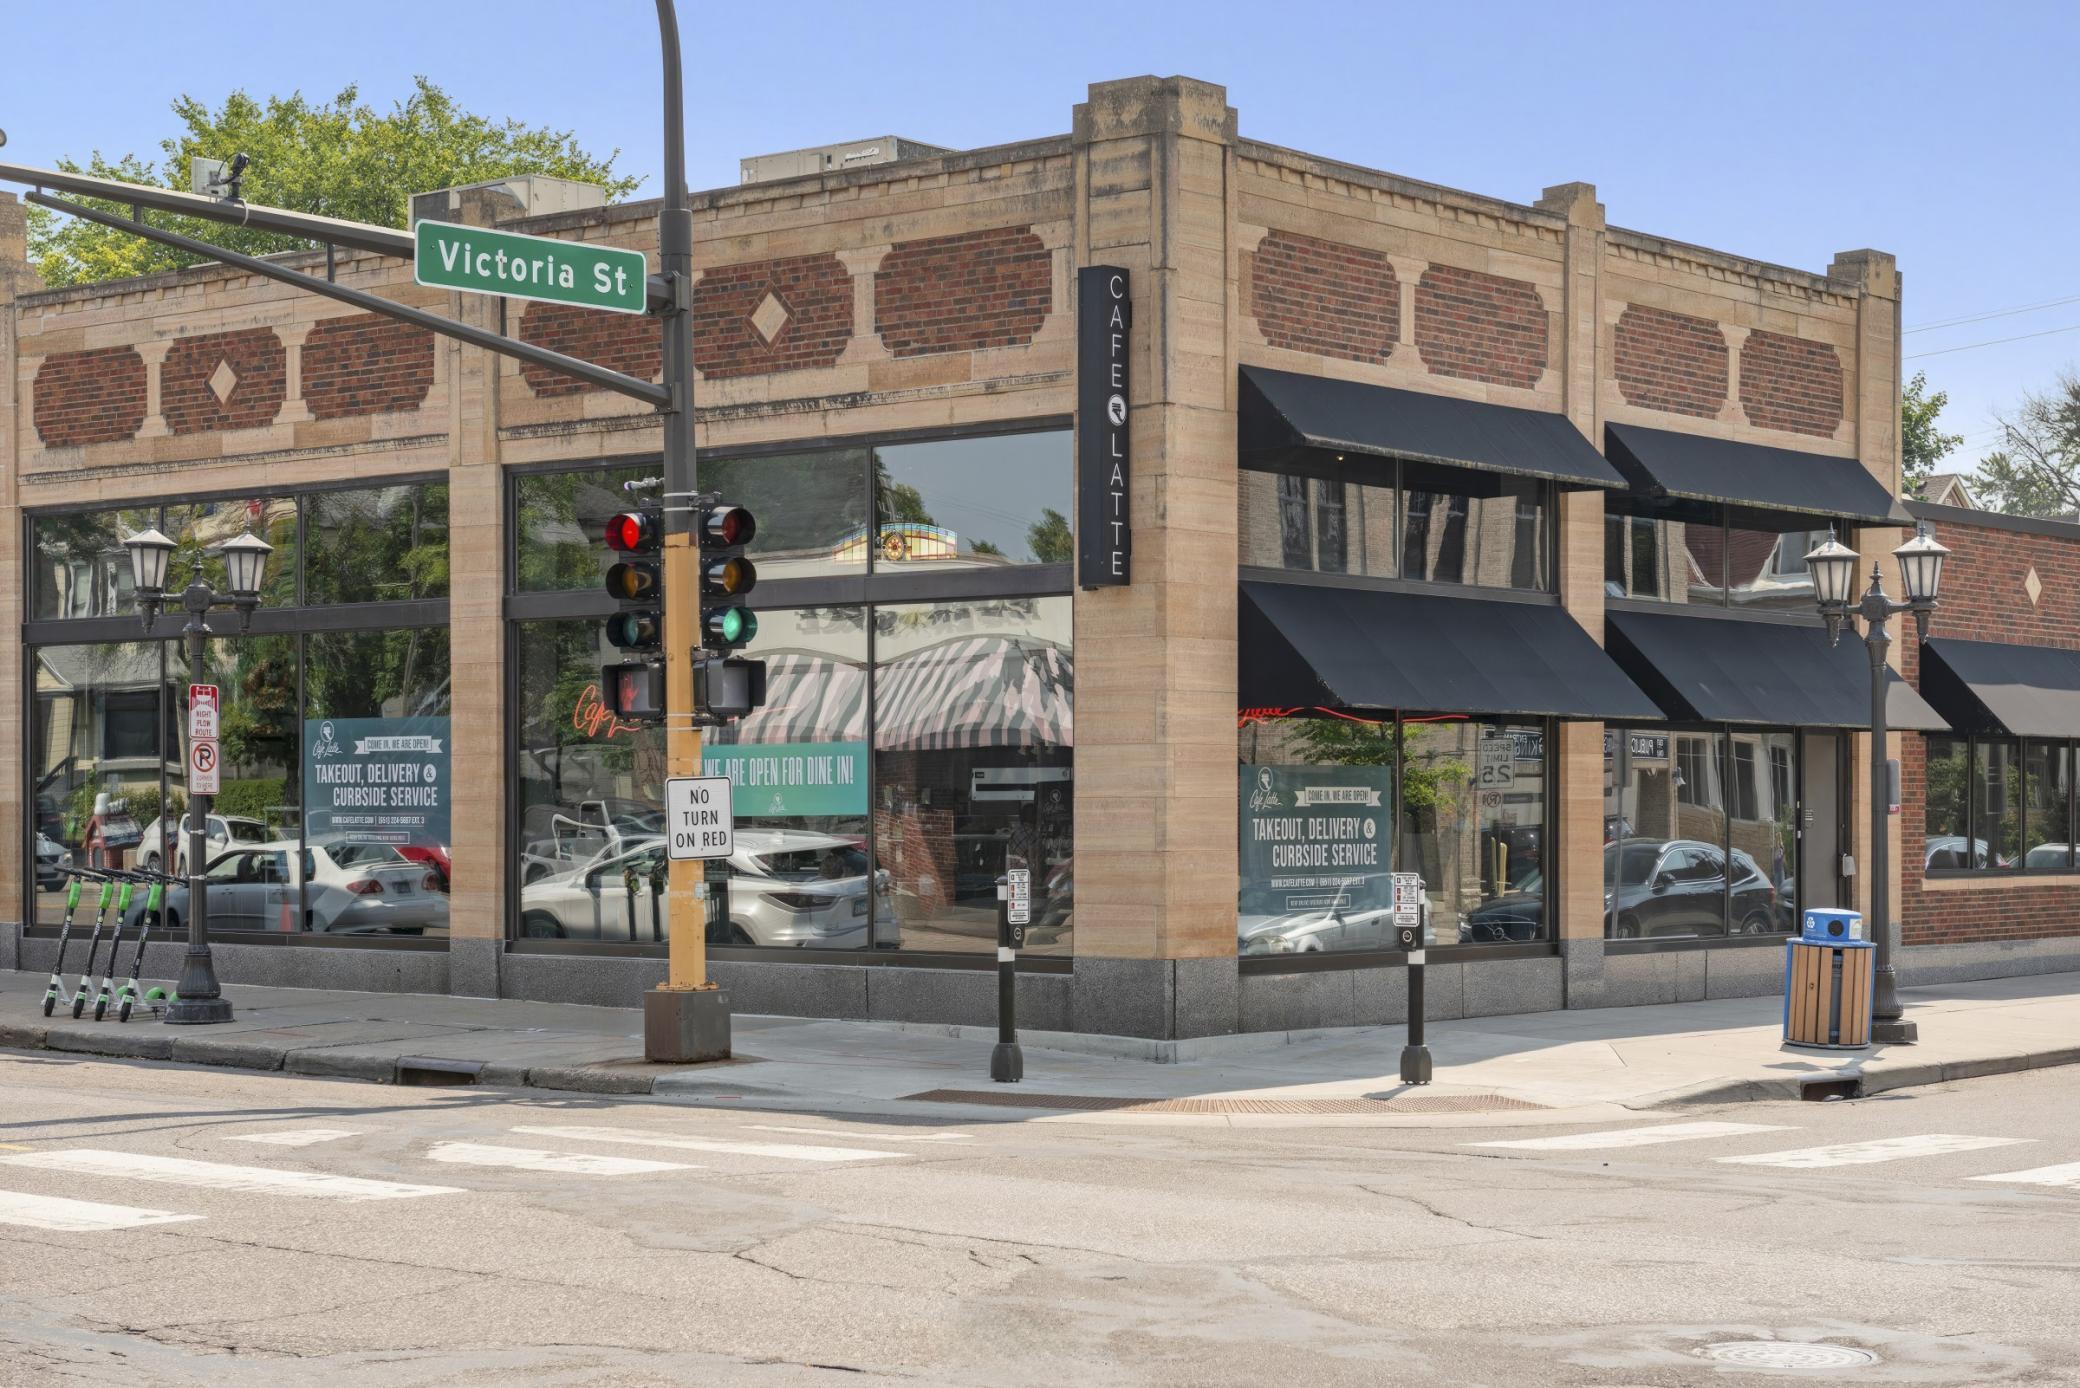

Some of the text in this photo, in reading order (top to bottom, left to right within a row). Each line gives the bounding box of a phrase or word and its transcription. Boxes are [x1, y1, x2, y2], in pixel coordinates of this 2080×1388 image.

[438, 239, 627, 296] Victoria St
[1110, 275, 1123, 575] CAFE LATTE
[196, 710, 212, 718] NIGHT
[367, 740, 382, 749] COME
[392, 739, 400, 749] WE
[401, 739, 411, 749] ARE
[315, 764, 364, 786] TAKEOUT,
[367, 763, 420, 784] DELIVERY
[725, 758, 746, 786] ARE
[750, 757, 778, 786] OPEN
[782, 757, 803, 785] FOR
[807, 756, 833, 785] DINE
[837, 755, 854, 784] IN!
[333, 786, 438, 806] CURBSIDE SERVICE
[690, 789, 709, 804] NO
[1307, 790, 1323, 801] COME
[1333, 790, 1342, 800] WE
[1342, 790, 1352, 800] ARE
[1353, 789, 1369, 800] OPEN!
[683, 810, 718, 826] TURN
[676, 831, 727, 848] ON RED
[1253, 818, 1305, 843] TAKEOUT,
[1308, 817, 1360, 840] DELIVERY
[1272, 844, 1377, 867] CURBSIDE SERVICE
